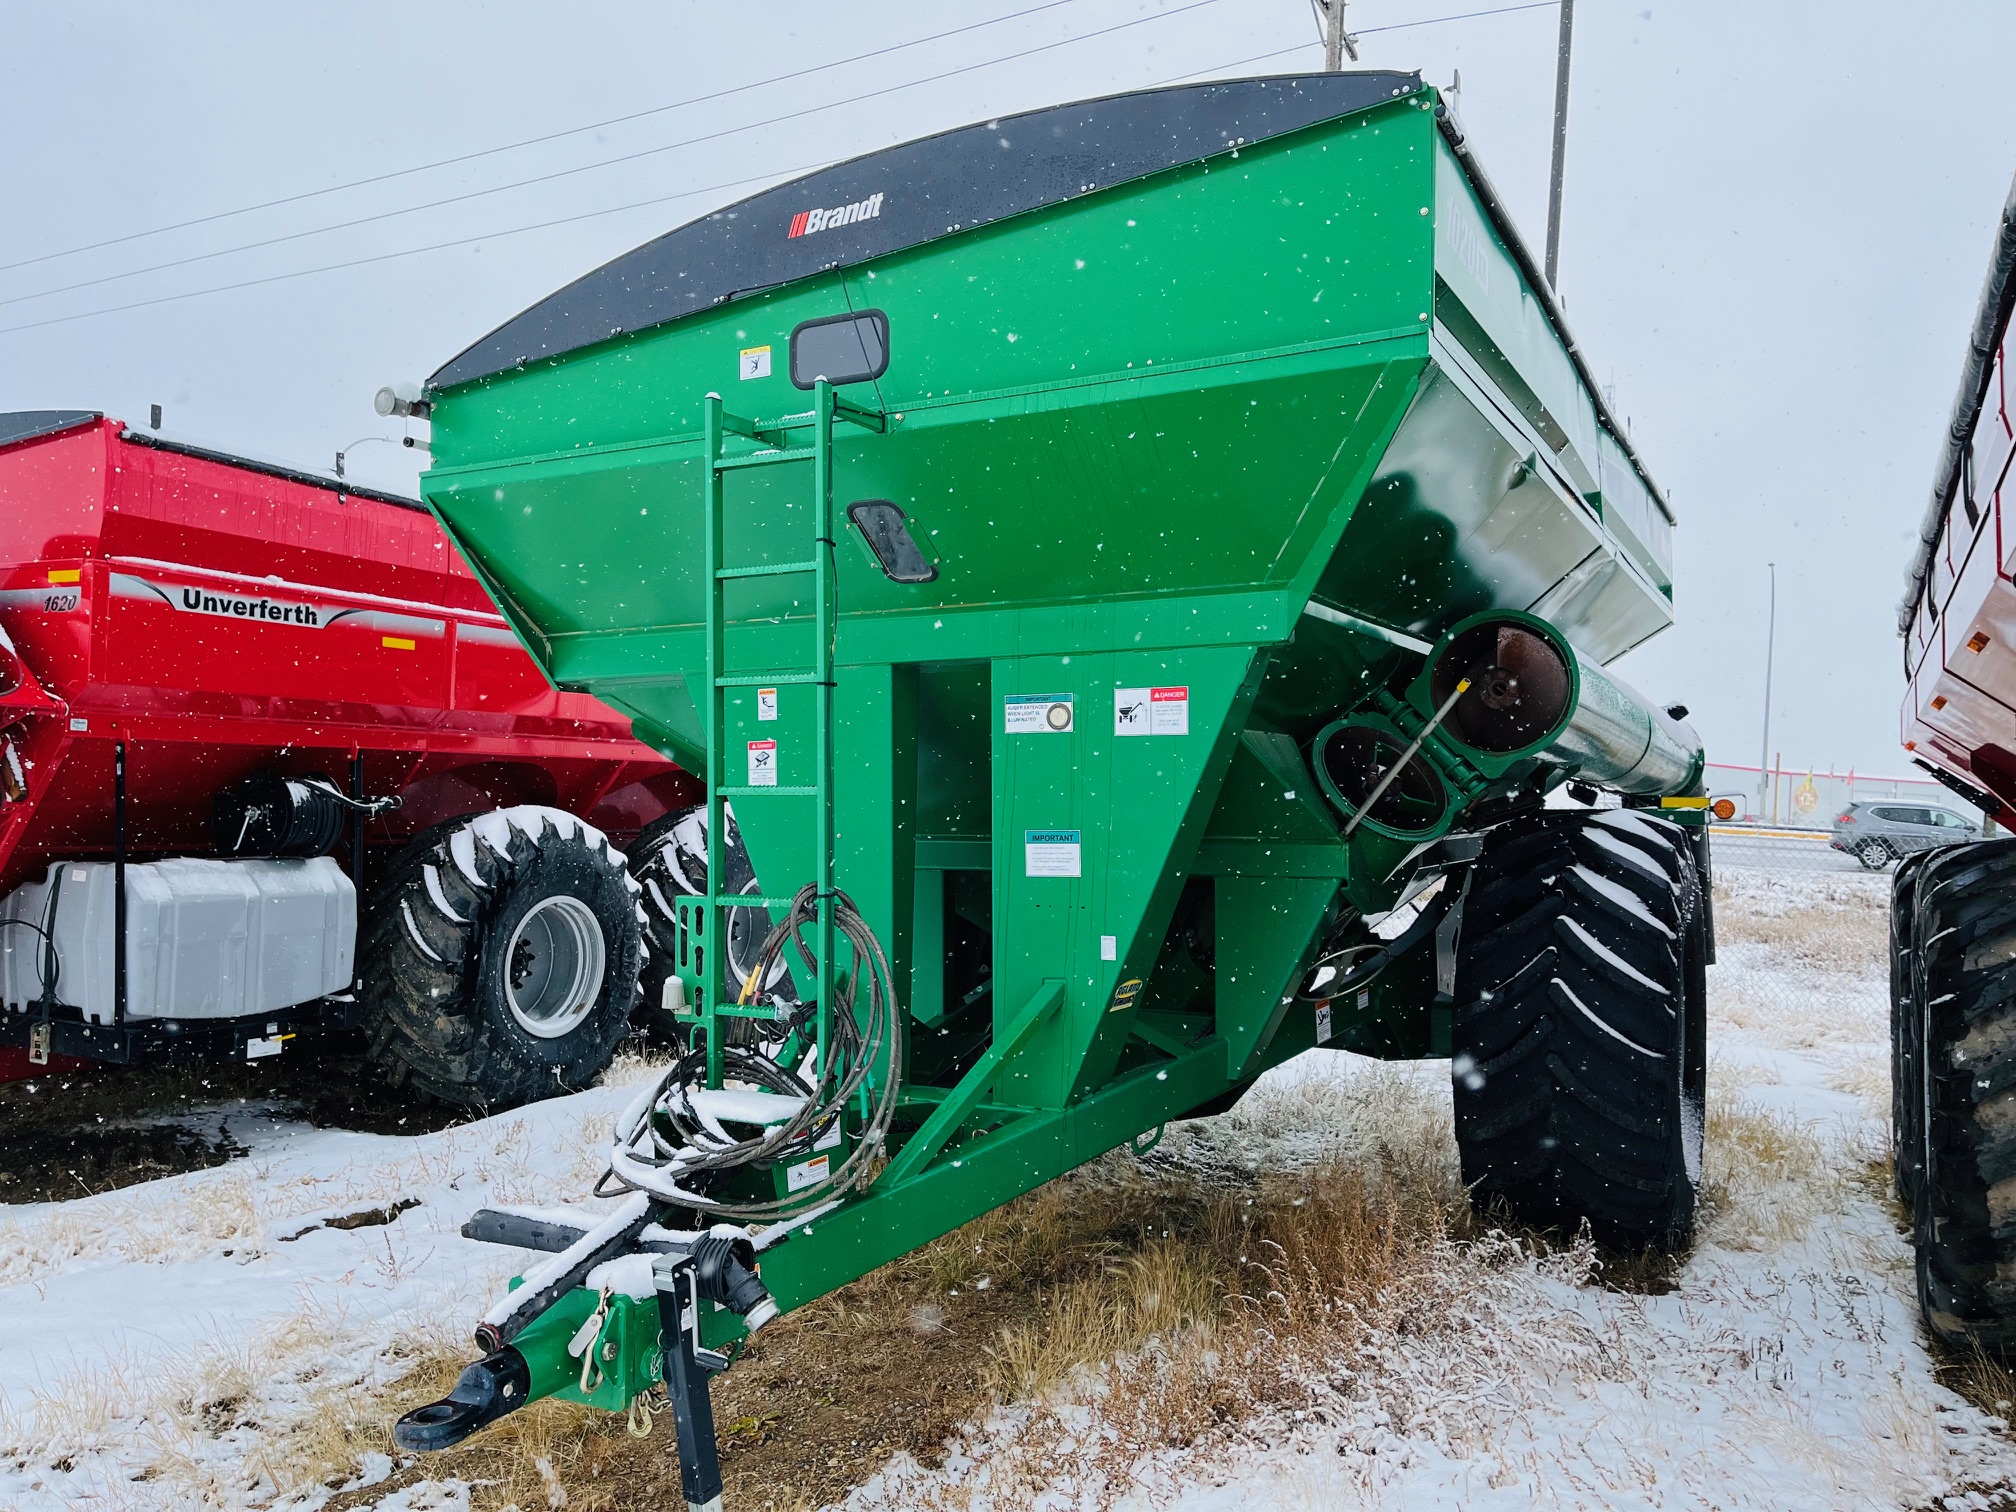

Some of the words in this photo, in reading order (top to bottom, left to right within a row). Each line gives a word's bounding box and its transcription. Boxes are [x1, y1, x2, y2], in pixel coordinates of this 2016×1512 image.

[804, 192, 884, 235] Brandt
[44, 595, 77, 612] 1620
[183, 588, 318, 626] Unverferth
[1032, 834, 1074, 842] IMPORTANT
